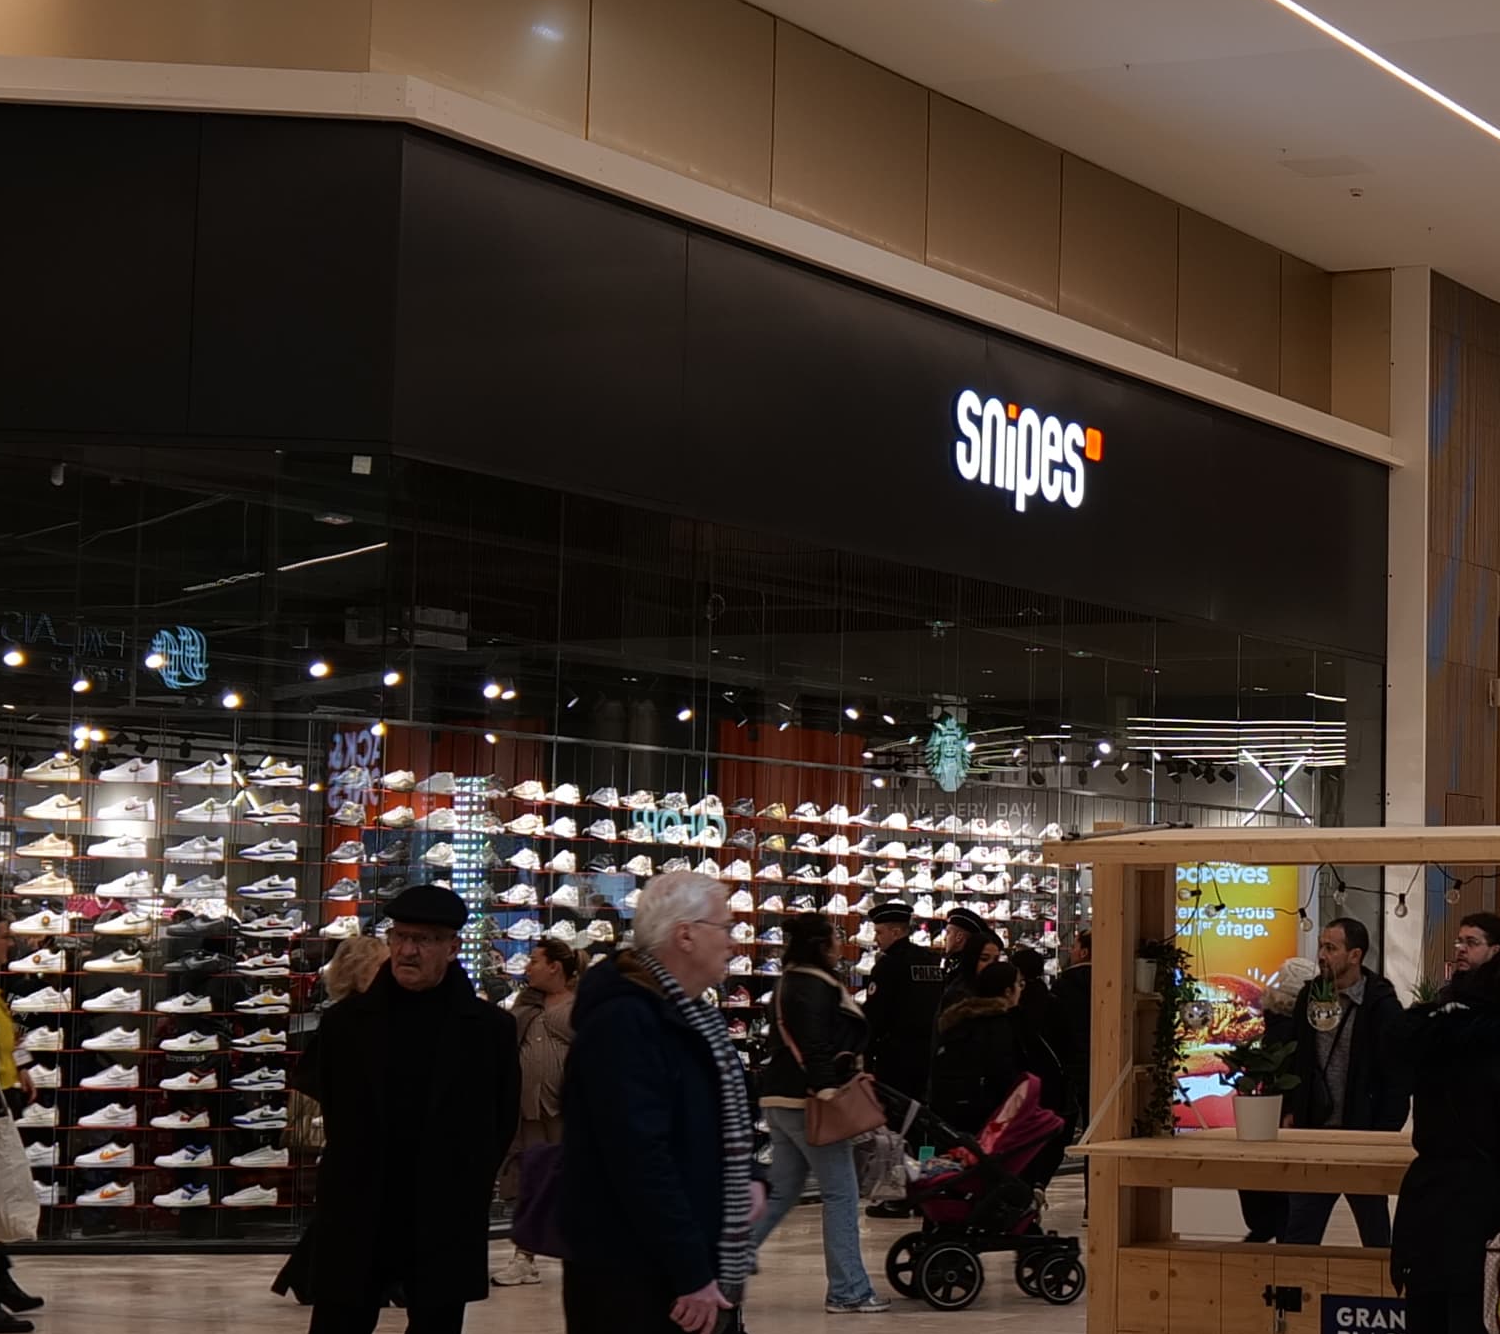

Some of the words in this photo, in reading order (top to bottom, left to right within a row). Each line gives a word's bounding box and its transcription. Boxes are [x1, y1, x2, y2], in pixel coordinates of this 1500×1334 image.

[954, 388, 1086, 513] snipes
[997, 802, 1037, 817] DAY!
[1216, 920, 1269, 939] étage.
[1336, 1306, 1407, 1331] GRAN
